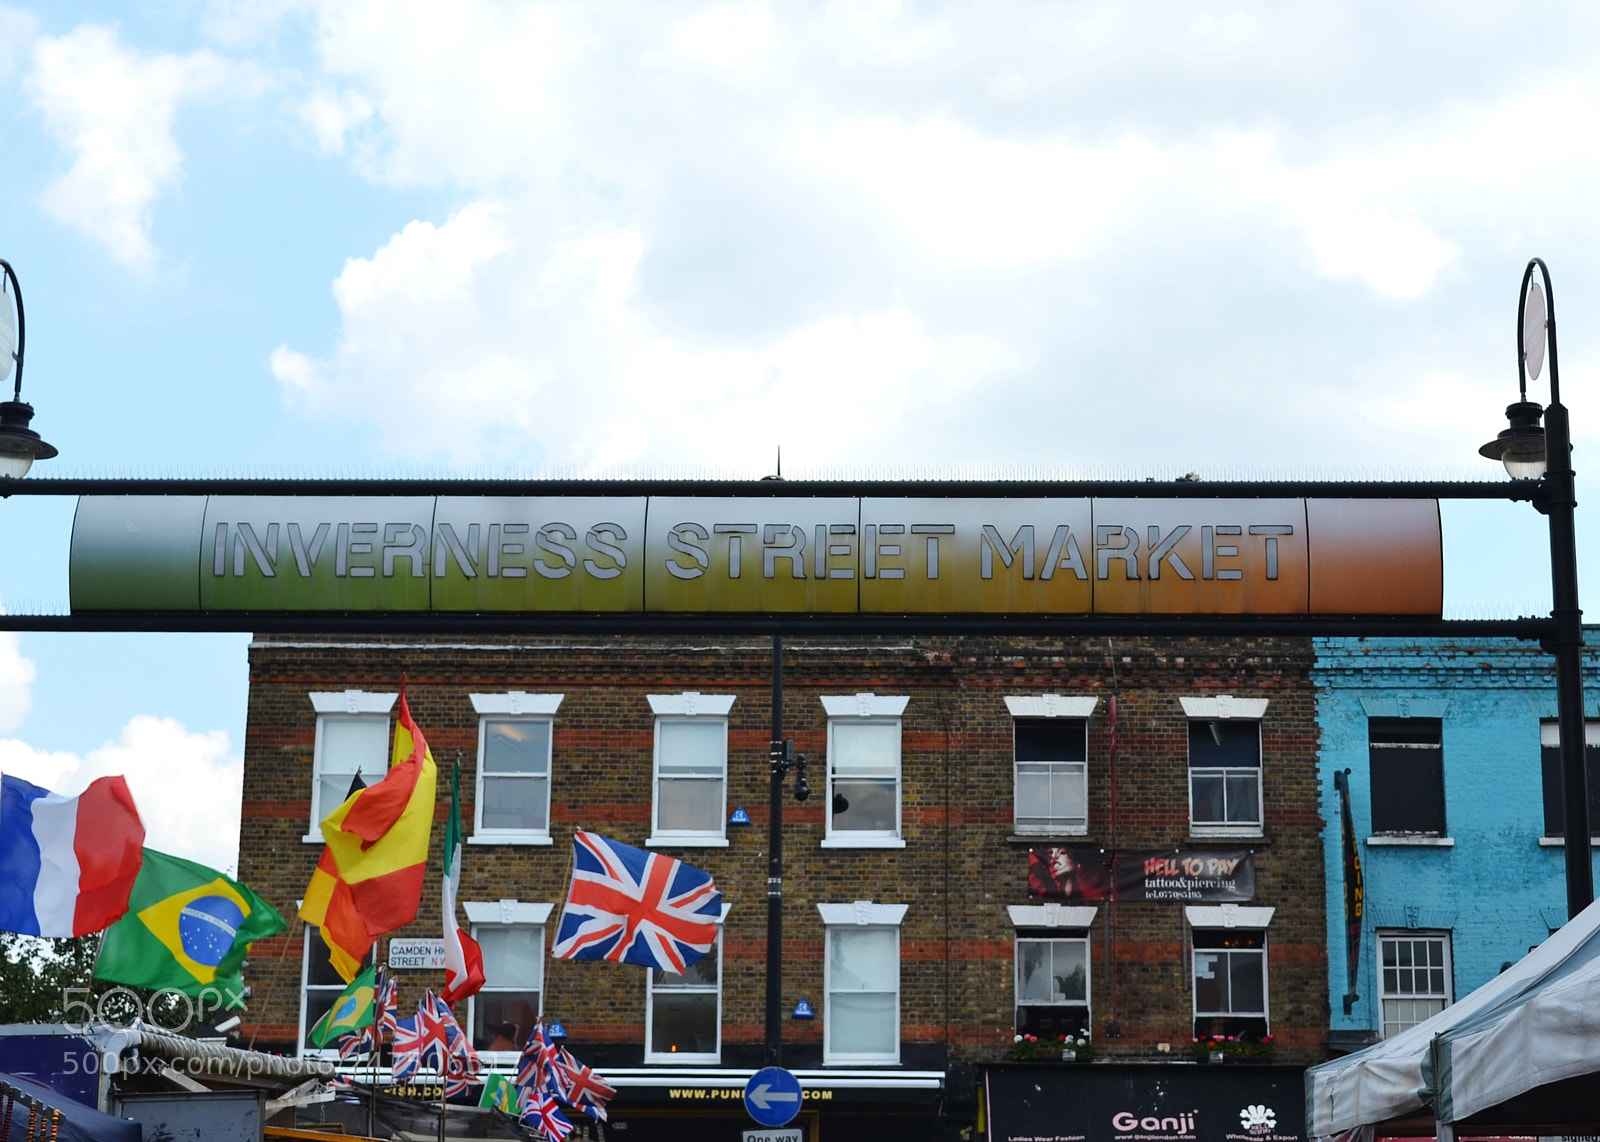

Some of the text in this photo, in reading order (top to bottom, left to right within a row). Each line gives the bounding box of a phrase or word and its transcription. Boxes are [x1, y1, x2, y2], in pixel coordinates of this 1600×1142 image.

[213, 522, 1294, 581] INVERNESS STREET MARKET
[1144, 857, 1240, 876] HELL TO PAY
[391, 946, 432, 955] CAMDEN
[390, 957, 426, 966] STREET
[1112, 1111, 1195, 1134] Ganji
[747, 1134, 798, 1142] One way
